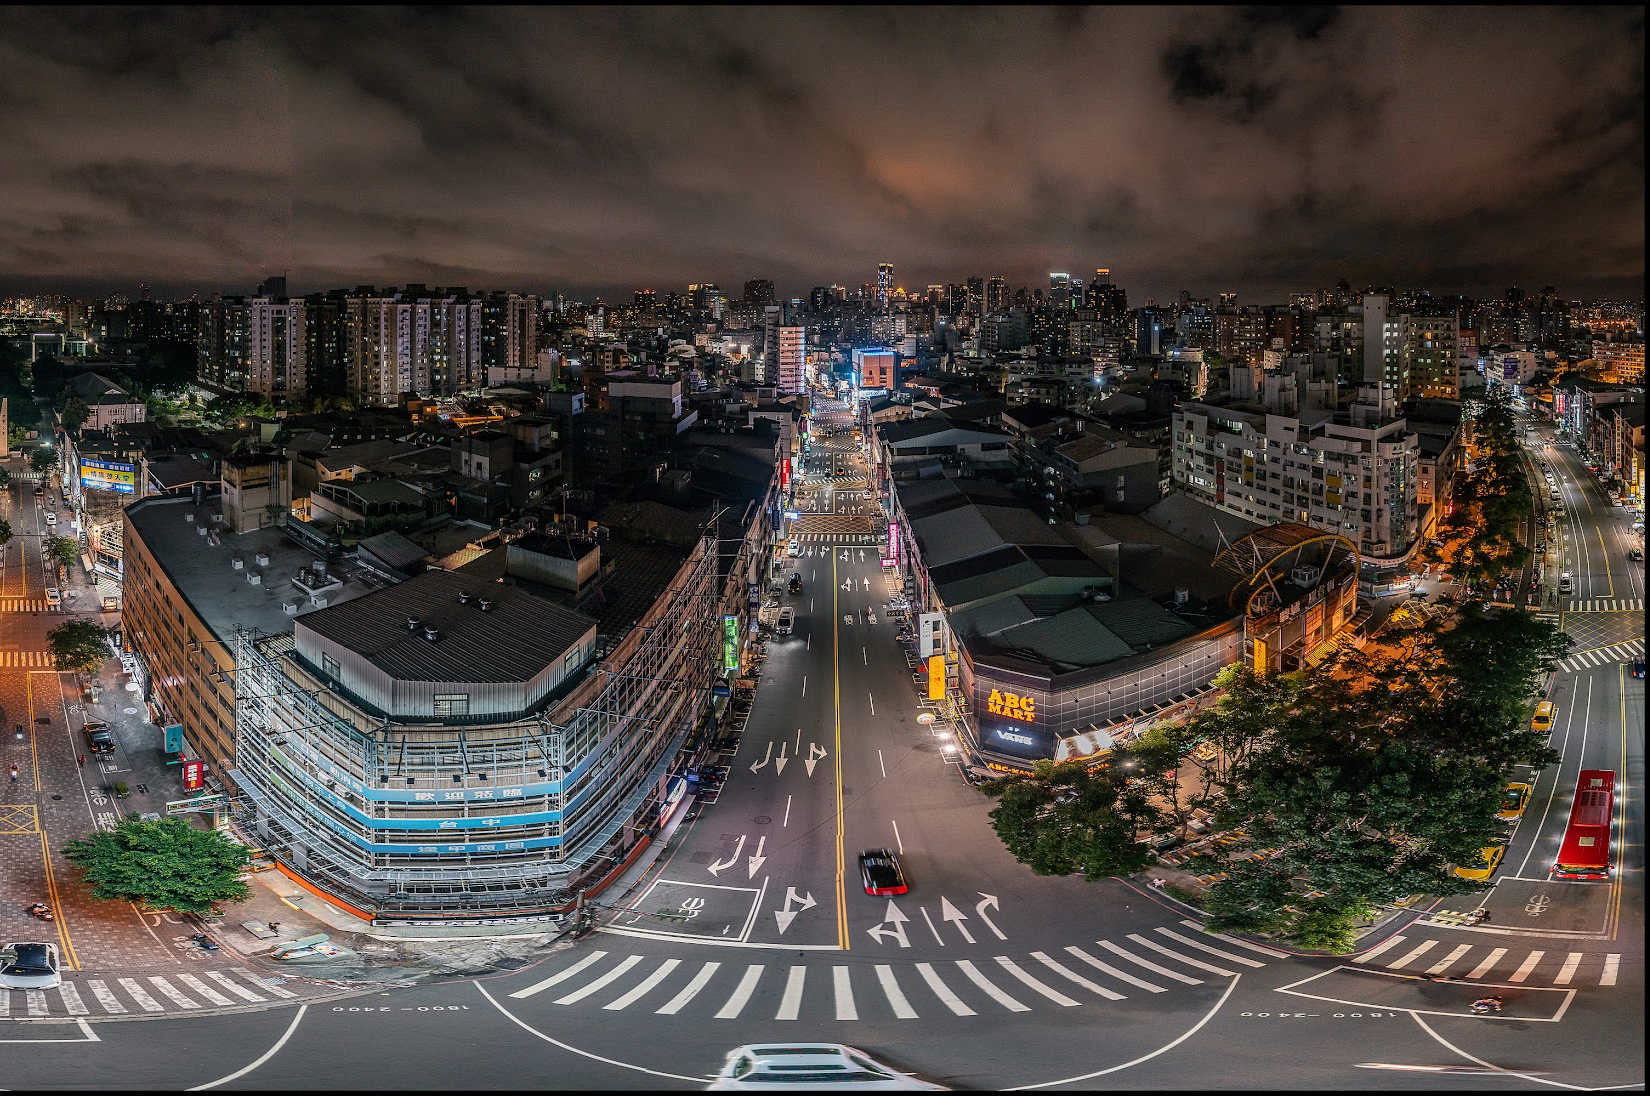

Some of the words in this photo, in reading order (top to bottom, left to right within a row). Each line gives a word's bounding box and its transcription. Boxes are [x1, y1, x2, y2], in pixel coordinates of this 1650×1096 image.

[987, 688, 1036, 712] ABC
[987, 702, 1036, 723] MART
[996, 729, 1033, 746] VANS
[415, 788, 522, 801] 歡迎蒞臨
[439, 819, 501, 829] 台中
